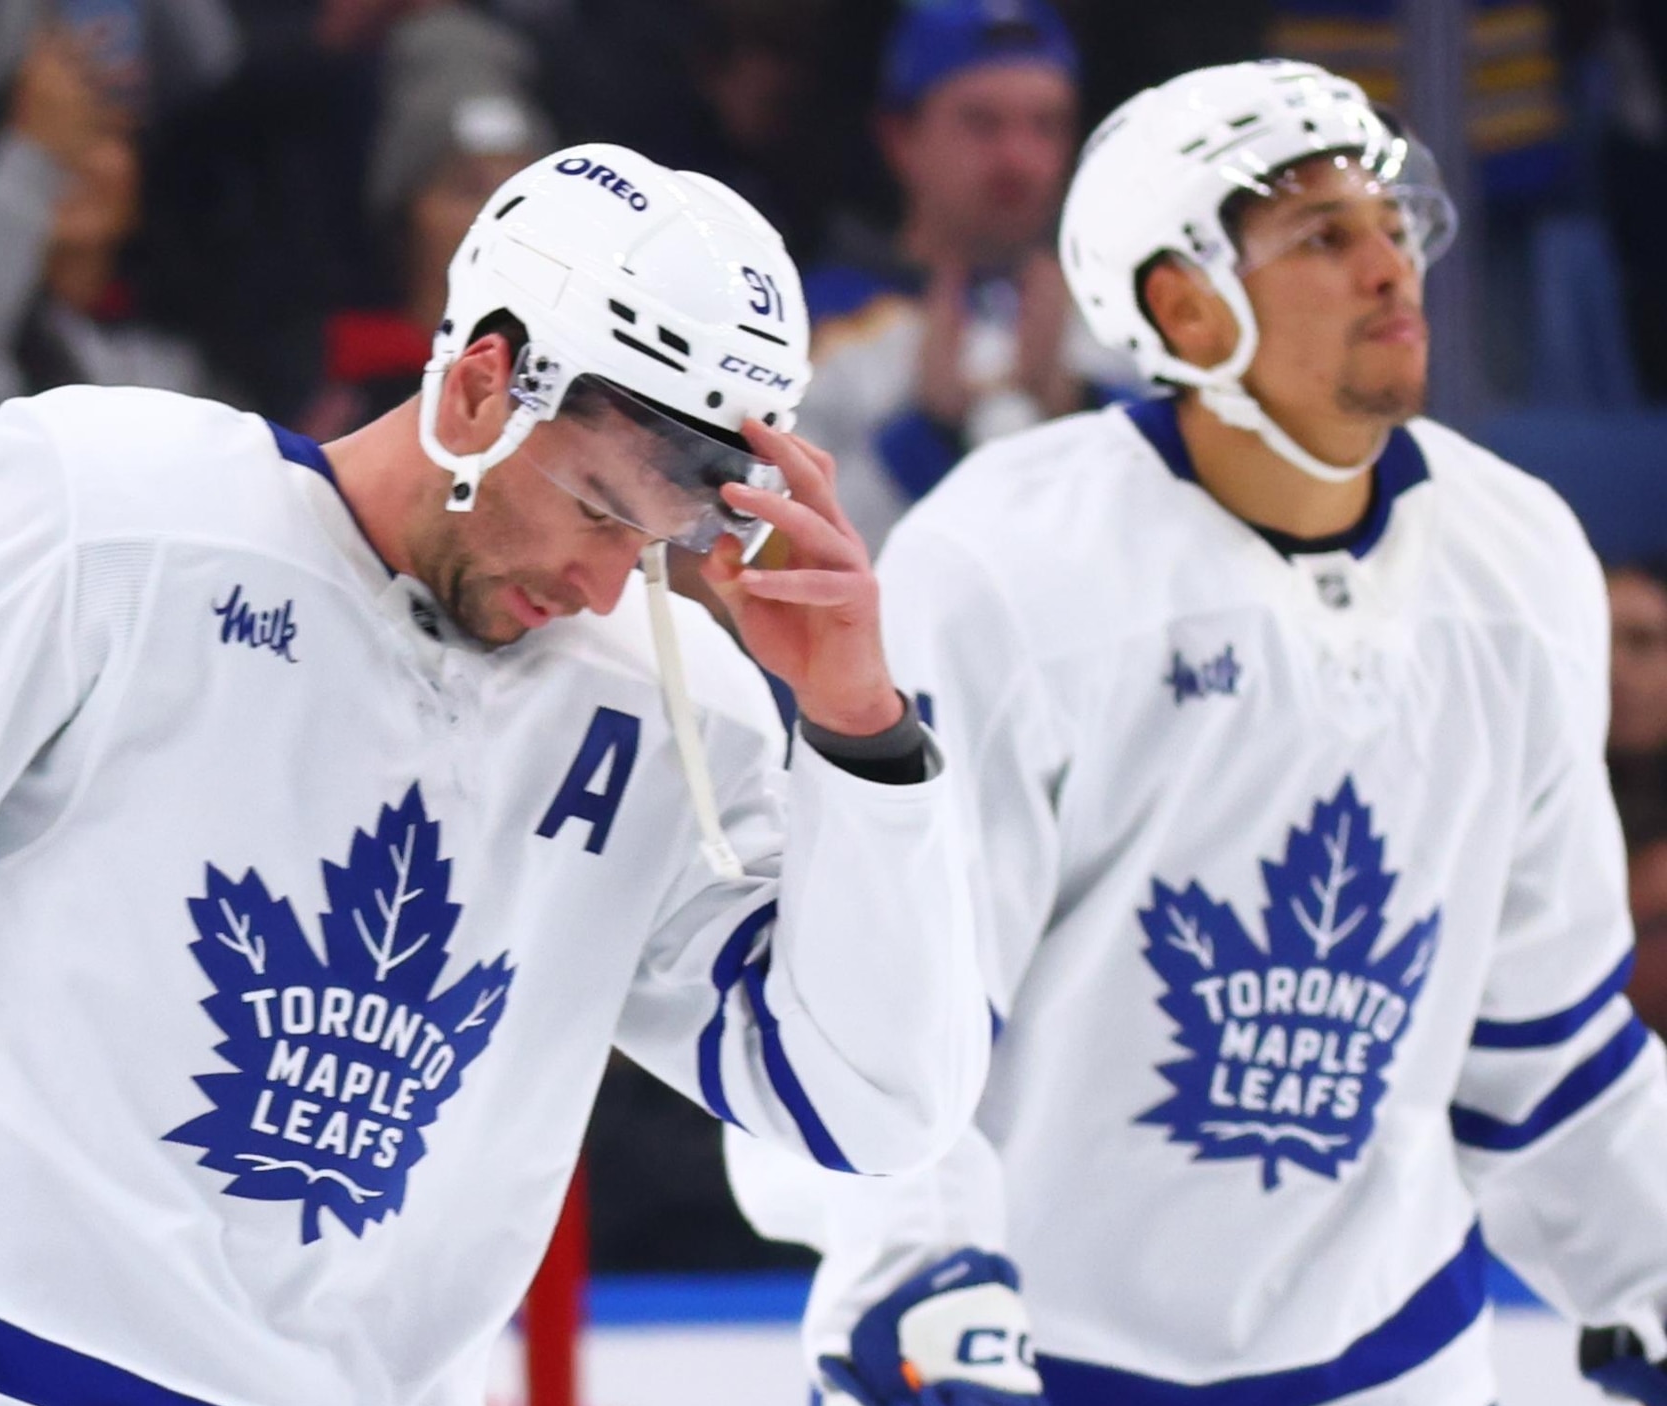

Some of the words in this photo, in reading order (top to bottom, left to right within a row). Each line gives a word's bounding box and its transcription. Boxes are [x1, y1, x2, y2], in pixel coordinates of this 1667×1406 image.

[554, 157, 649, 212] OREO
[741, 265, 785, 323] 91
[718, 353, 795, 391] CCM
[212, 584, 300, 664] Milk
[534, 706, 642, 855] A
[241, 986, 455, 1091] TORONTO
[1191, 967, 1407, 1042] TORONTO
[267, 1039, 422, 1121] MAPLE
[1220, 1020, 1374, 1074] MAPLE
[1209, 1062, 1362, 1119] LEAFS
[250, 1090, 404, 1169] LEAFS
